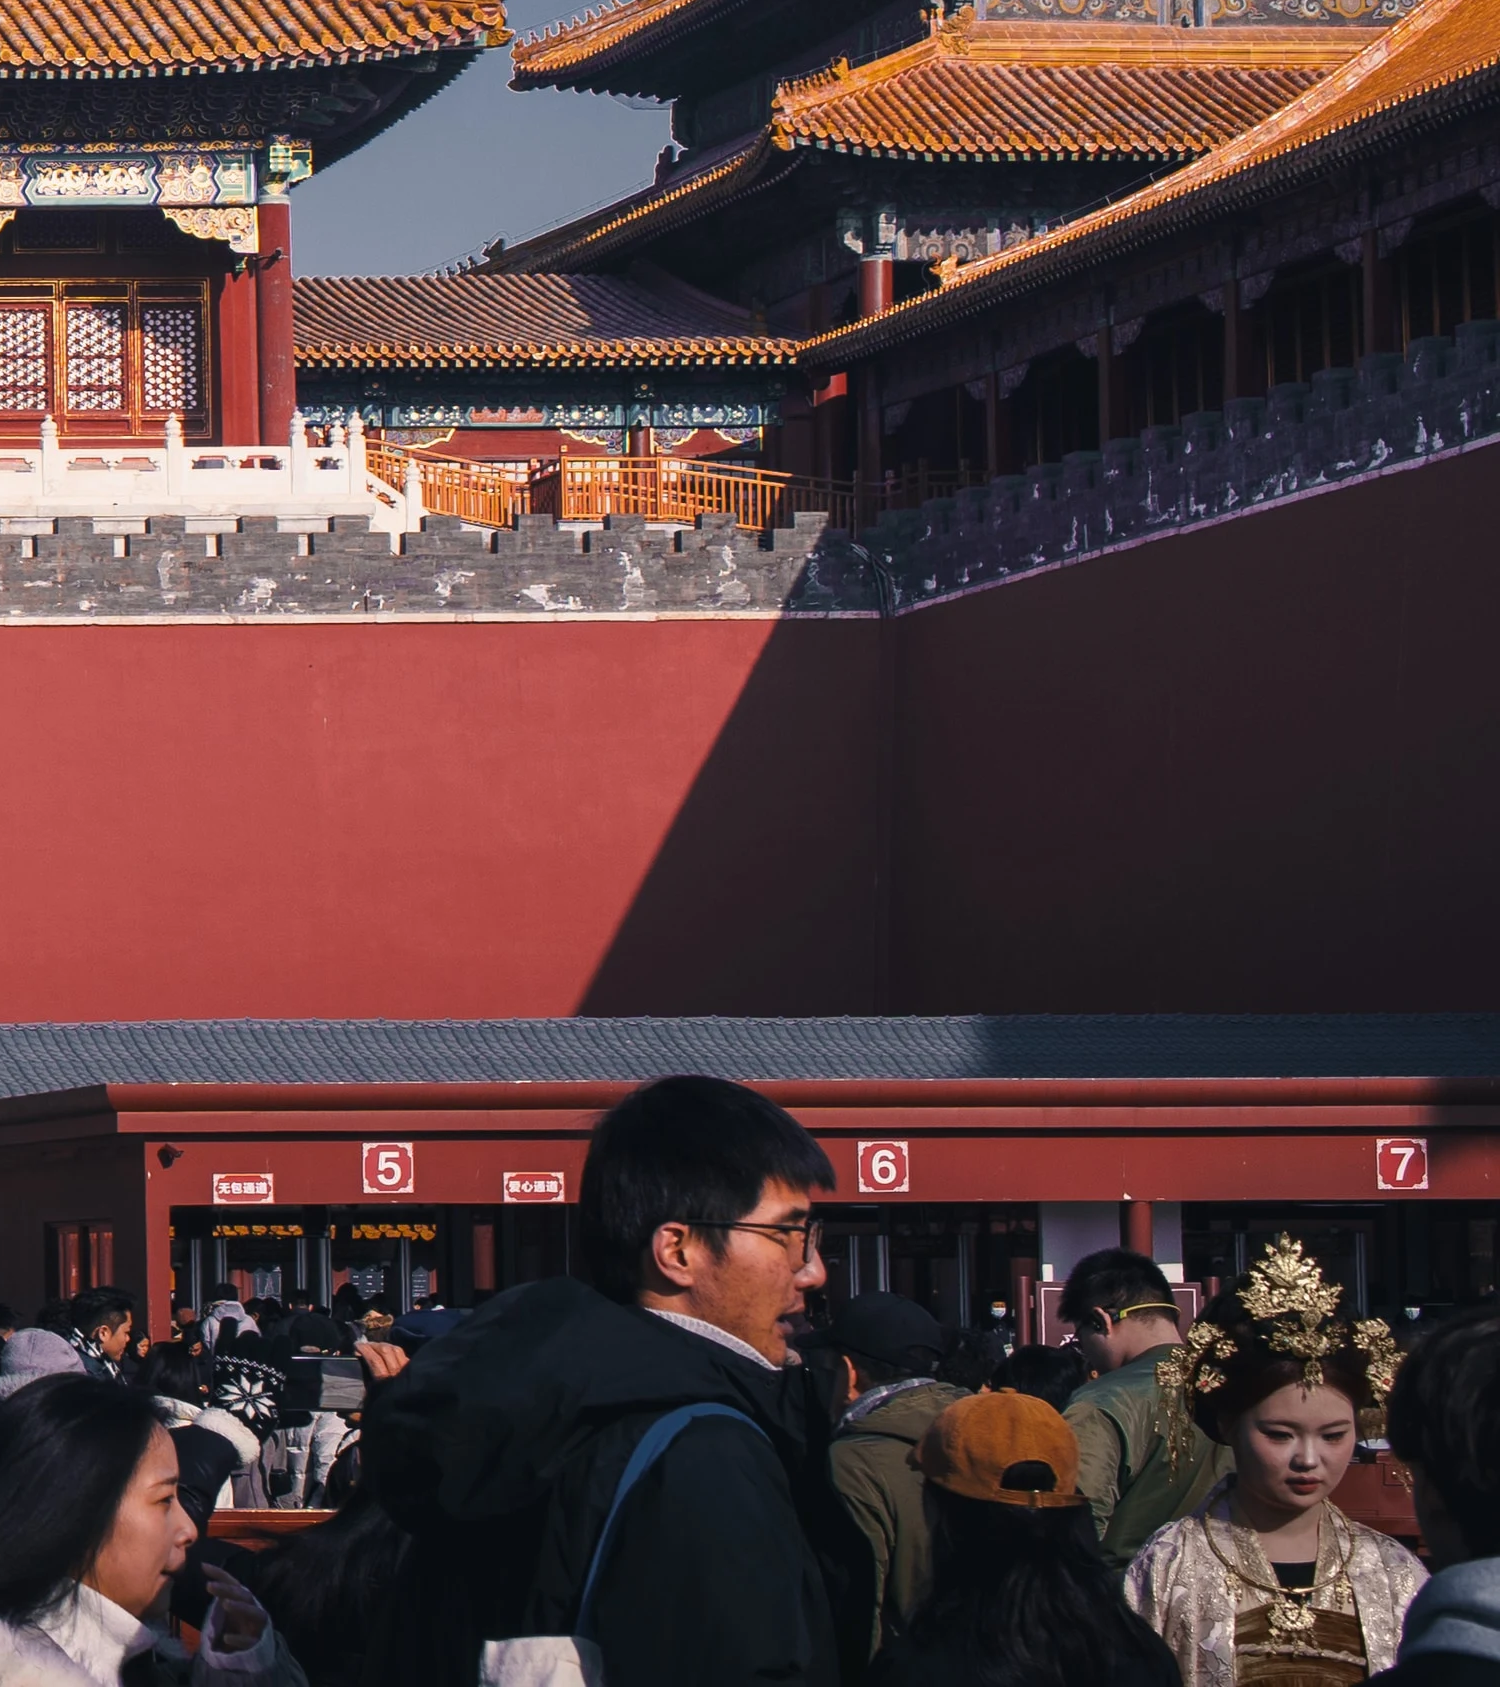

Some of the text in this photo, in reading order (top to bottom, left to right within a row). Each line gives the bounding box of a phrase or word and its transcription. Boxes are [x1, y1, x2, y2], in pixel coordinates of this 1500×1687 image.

[377, 1152, 401, 1185] 5
[872, 1150, 896, 1184] 6
[1391, 1148, 1414, 1180] 7
[218, 1182, 267, 1194] 无包通道
[509, 1180, 559, 1193] 爱心通道
